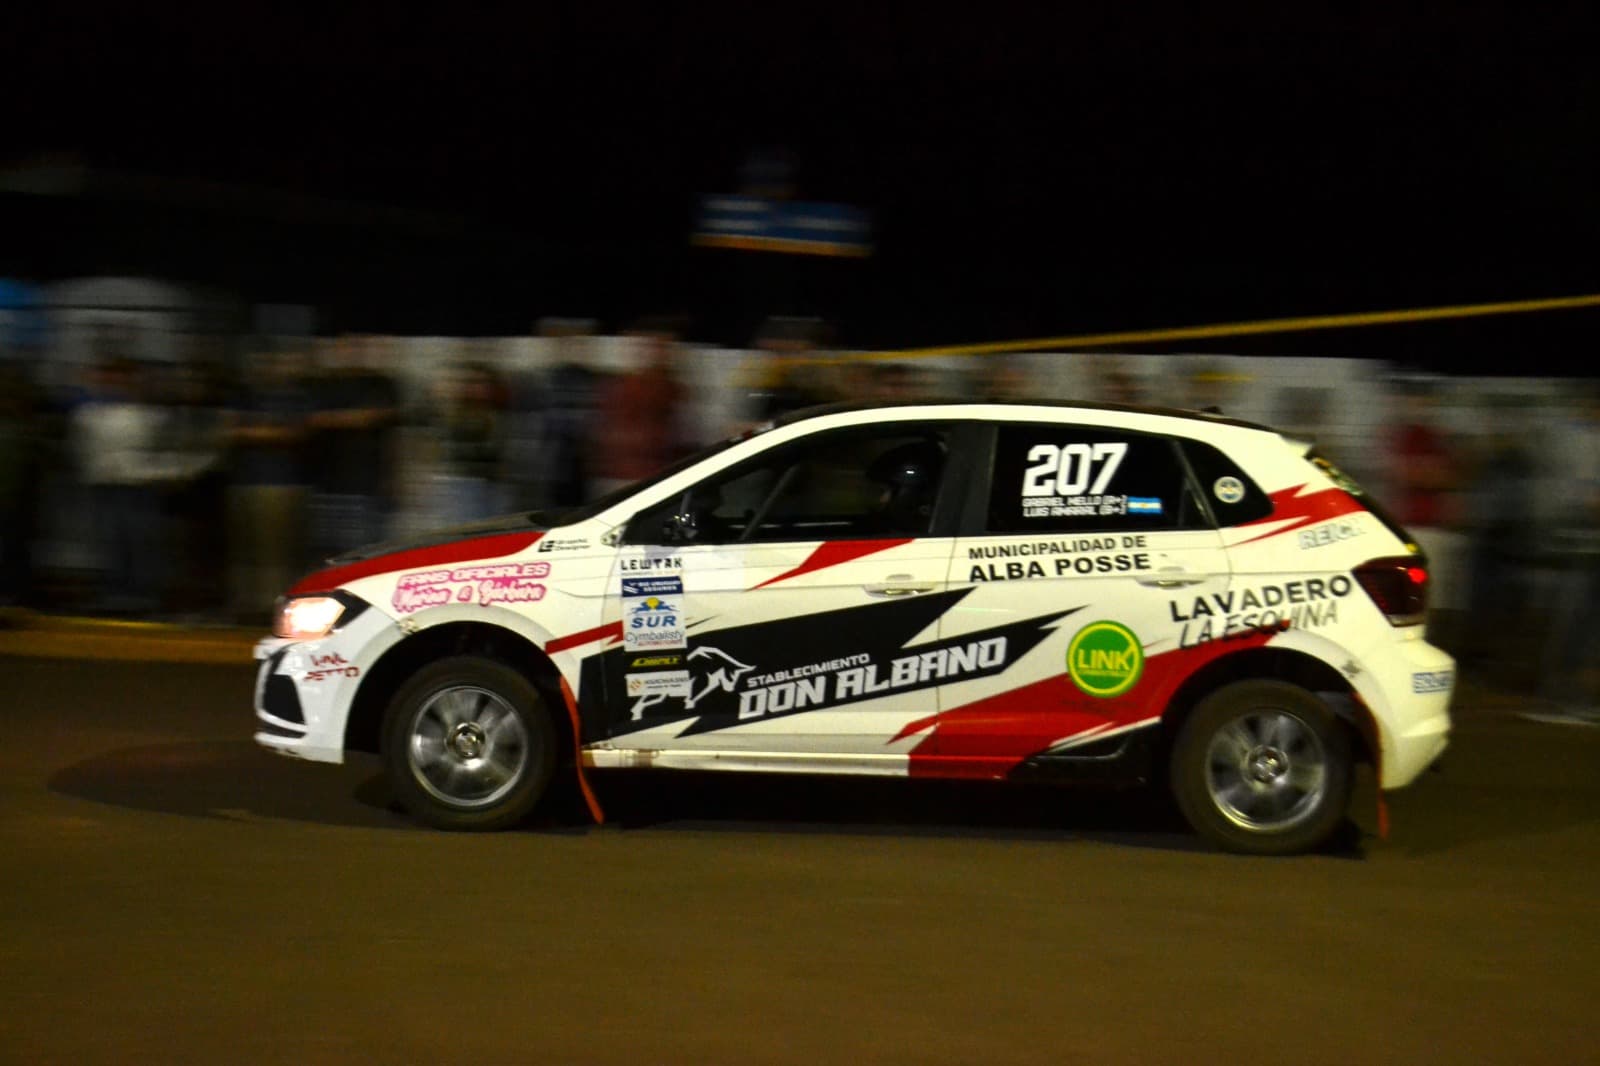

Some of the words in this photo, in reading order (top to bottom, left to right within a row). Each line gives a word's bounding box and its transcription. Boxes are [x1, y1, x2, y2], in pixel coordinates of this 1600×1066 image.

[1021, 443, 1128, 496] 207
[969, 538, 1116, 560] MUNICIPALIDAD
[1122, 535, 1147, 549] DE
[452, 564, 550, 580] OFICIALES
[969, 561, 1046, 583] ALBA
[1055, 553, 1152, 576] POSSE
[1170, 575, 1352, 622] LAVADERO
[631, 615, 677, 629] SUR
[1180, 619, 1213, 649] LA
[1222, 601, 1338, 641] ESQUINA
[747, 653, 870, 688] STABLECIMIENTO
[1078, 648, 1131, 671] LINK
[738, 675, 827, 720] DON
[835, 636, 1008, 700] ALBANO
